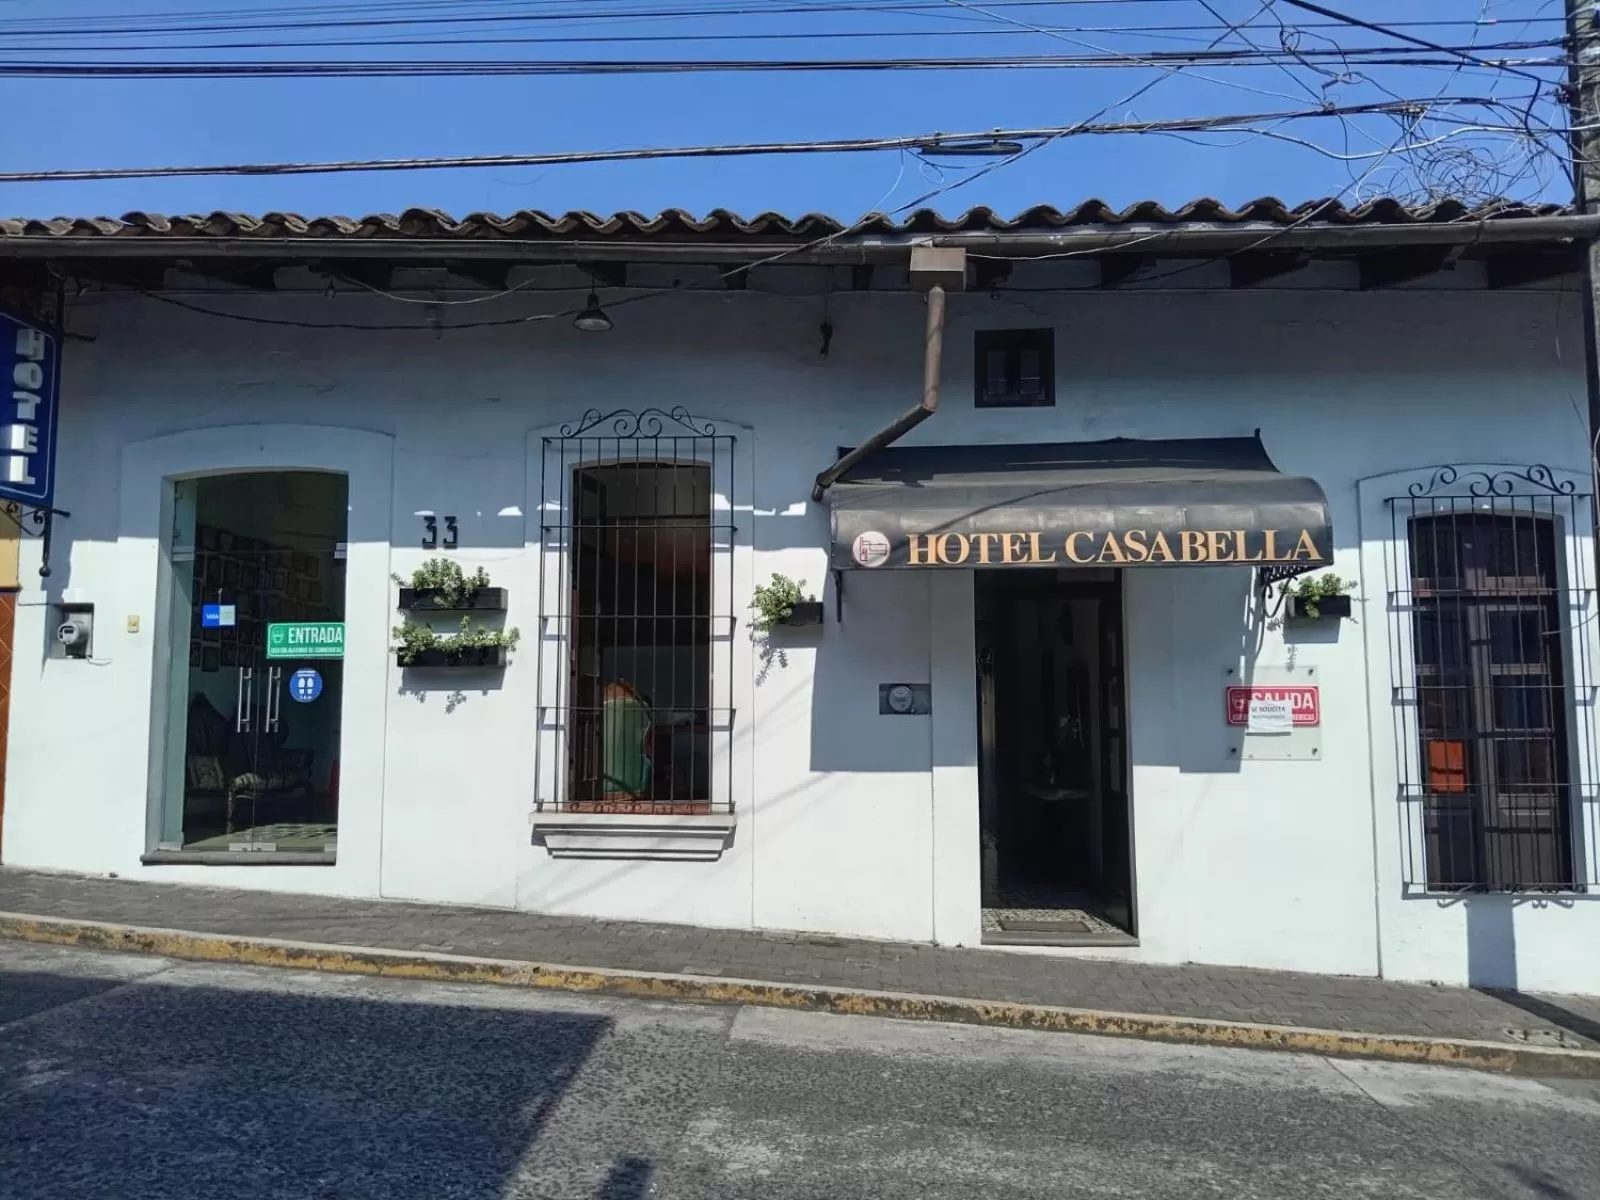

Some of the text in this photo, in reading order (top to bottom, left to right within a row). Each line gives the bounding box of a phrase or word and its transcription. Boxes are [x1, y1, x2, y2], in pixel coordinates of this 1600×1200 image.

[10, 328, 45, 485] HOTEL
[422, 516, 458, 550] 33
[906, 528, 1324, 566] HOTEL CASABELLA
[288, 626, 343, 644] ENTRADA
